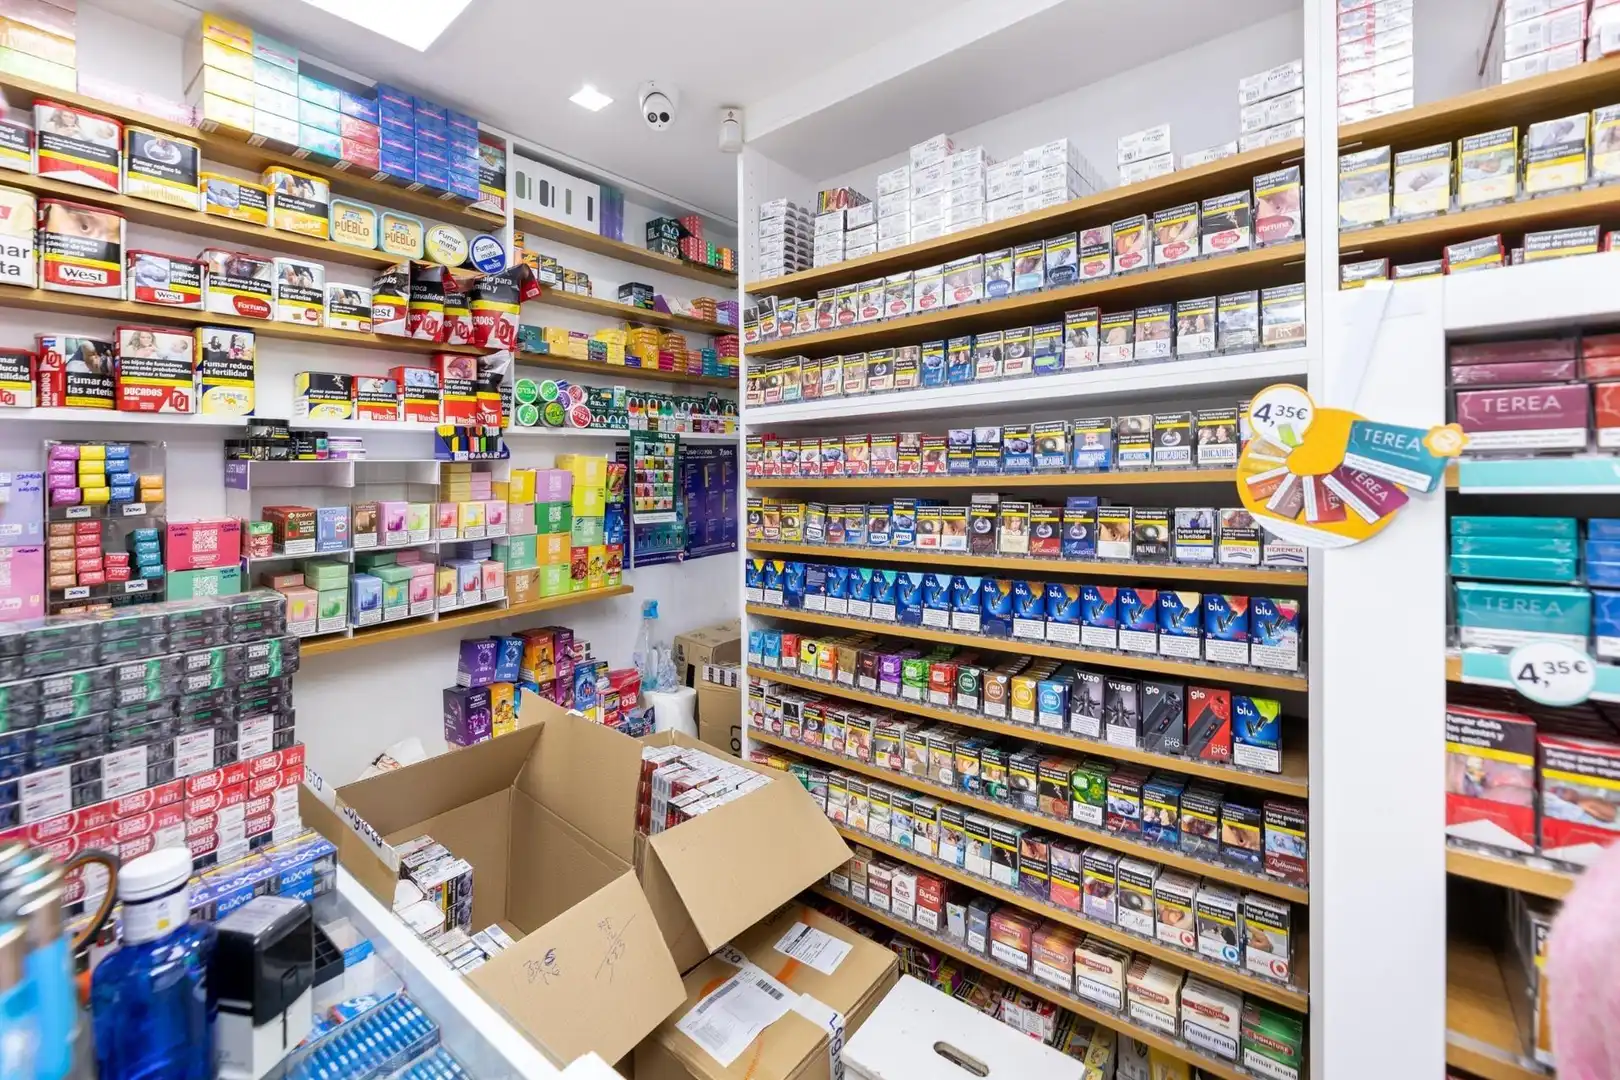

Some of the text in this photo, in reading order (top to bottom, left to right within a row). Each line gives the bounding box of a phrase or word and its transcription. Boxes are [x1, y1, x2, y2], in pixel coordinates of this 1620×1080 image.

[335, 220, 369, 236] PUEBLO
[1258, 221, 1289, 233] Fortuna
[385, 232, 416, 247] PUEBLO
[438, 230, 461, 245] Fumar
[439, 238, 457, 251] mata
[476, 243, 495, 252] Fumar
[481, 250, 496, 258] mata
[171, 262, 195, 272] Fumar
[63, 266, 103, 281] West
[171, 271, 199, 280] provoca
[171, 277, 199, 287] infartos
[494, 277, 512, 285] para
[157, 290, 182, 300] West
[280, 286, 299, 294] Fumar
[238, 301, 267, 312] Fortuna
[203, 360, 253, 371] Fumar reduce
[211, 369, 248, 377] fertilidad
[67, 375, 100, 388] Fumar
[41, 373, 51, 406] DUCADOS
[67, 386, 114, 396] las arteria
[123, 388, 163, 397] DUCADOS
[1482, 395, 1562, 413] TEREA
[373, 412, 395, 420] Winston
[418, 414, 439, 422] Winston
[1253, 403, 1307, 427] 4,35€
[1364, 428, 1420, 452] TEREA
[1123, 452, 1148, 460] DUCADOS
[1157, 450, 1188, 460] DUCADOS
[1201, 448, 1235, 459] DUCADOS
[1005, 456, 1031, 467] DUCADOS
[1350, 469, 1389, 502] TEREA
[926, 579, 936, 587] blu
[954, 580, 965, 590] blu
[984, 585, 996, 593] blu
[1015, 587, 1027, 595] blu
[1050, 590, 1062, 598] blu
[1084, 592, 1097, 601] blu
[1121, 595, 1136, 604] blu
[1162, 598, 1177, 608] blu
[1208, 601, 1224, 611] blu
[1484, 596, 1563, 616] TEREA
[1077, 672, 1099, 683] vuse
[1517, 660, 1588, 688] 4,35€
[1108, 681, 1132, 692] vuse
[1146, 686, 1159, 695] glo
[1190, 690, 1205, 699] glo
[1164, 739, 1180, 748] pro
[1211, 746, 1228, 755] pro
[256, 755, 276, 766] LUCKY
[255, 762, 277, 773] STRIKE
[192, 773, 216, 785] LUCKY
[256, 775, 276, 786] LUCKY
[192, 780, 217, 792] STRIKE
[256, 782, 278, 793] STRIKE
[191, 794, 216, 806] LUCKY
[191, 802, 217, 814] STRIKE
[1266, 812, 1305, 825] Fumar provoca
[1266, 817, 1287, 827] infartos
[919, 889, 939, 902] Burton
[918, 905, 936, 917] Fumar
[1246, 906, 1262, 915] Fumar
[919, 916, 934, 924] mata
[992, 944, 1027, 963] Fumar mata
[1080, 979, 1120, 1000] Fumar mata
[1131, 1004, 1174, 1028] Fumar mata
[1194, 1003, 1227, 1020] SIGNATURE
[1185, 1024, 1235, 1050] Fumar mata
[1253, 1034, 1288, 1053] SIGNATURE
[1245, 1049, 1297, 1080] Fumar mata
